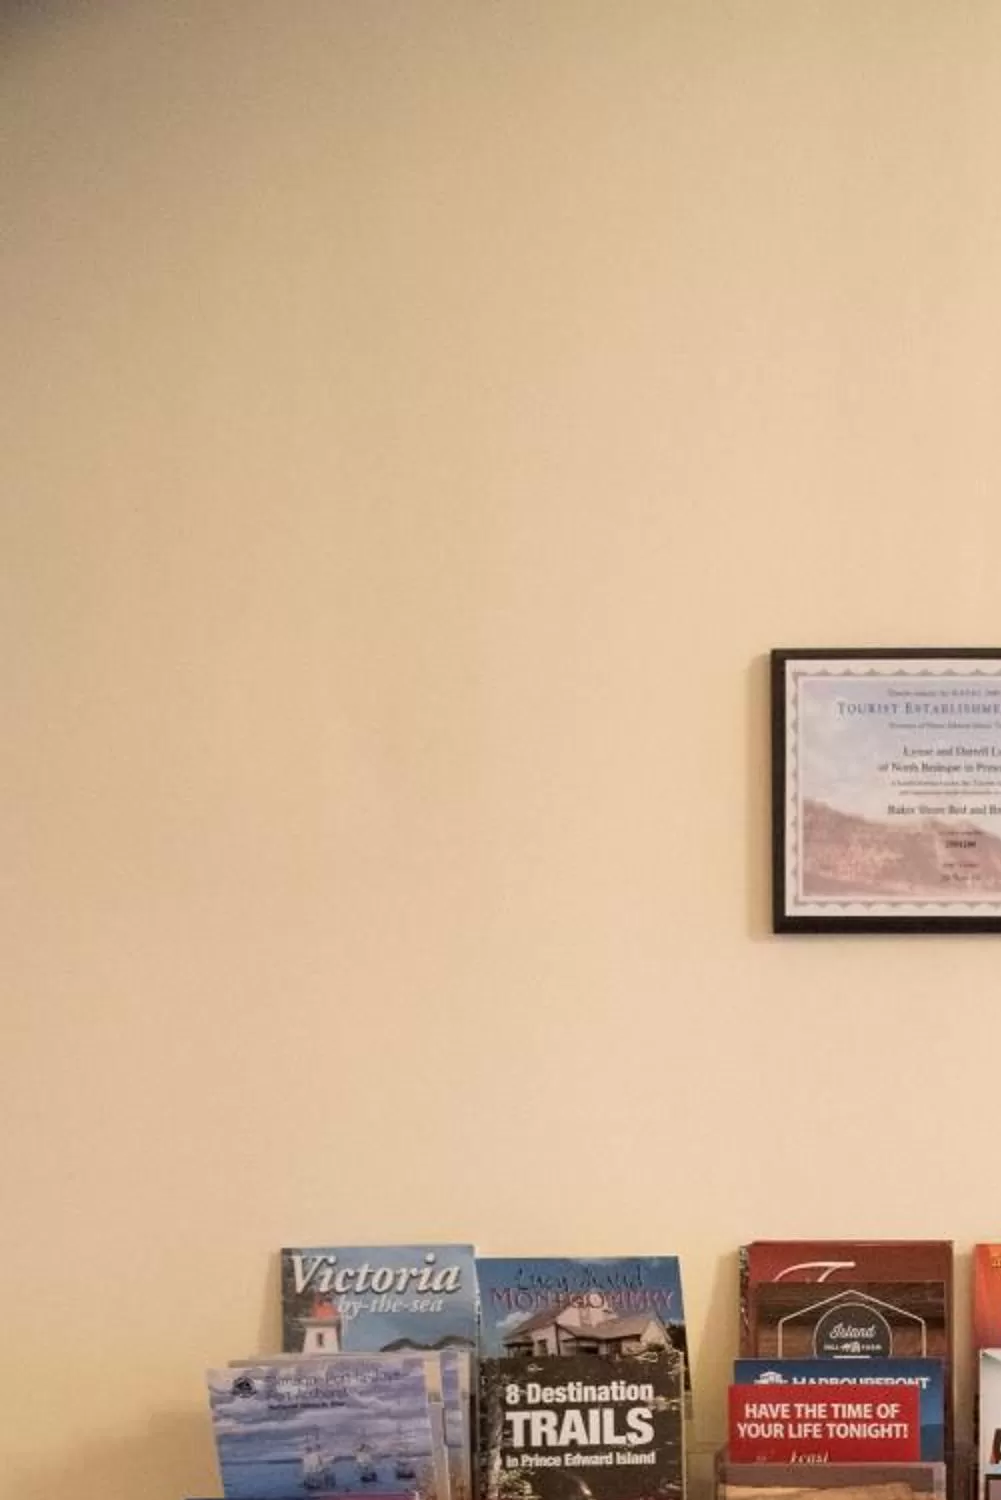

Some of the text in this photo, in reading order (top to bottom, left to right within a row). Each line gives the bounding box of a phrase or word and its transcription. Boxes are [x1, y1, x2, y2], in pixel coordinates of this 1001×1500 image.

[837, 702, 898, 716] TOURIST
[970, 805, 986, 815] and
[290, 1252, 462, 1294] Victoria
[337, 1295, 444, 1320] by-the-sea
[505, 1381, 655, 1404] 8 Destination
[745, 1403, 900, 1419] HAVE THE TIME OF
[505, 1407, 656, 1448] TRAILS
[737, 1422, 909, 1439] YOUR LIFE TONIGHT!
[506, 1451, 656, 1467] in Prince Edward Island
